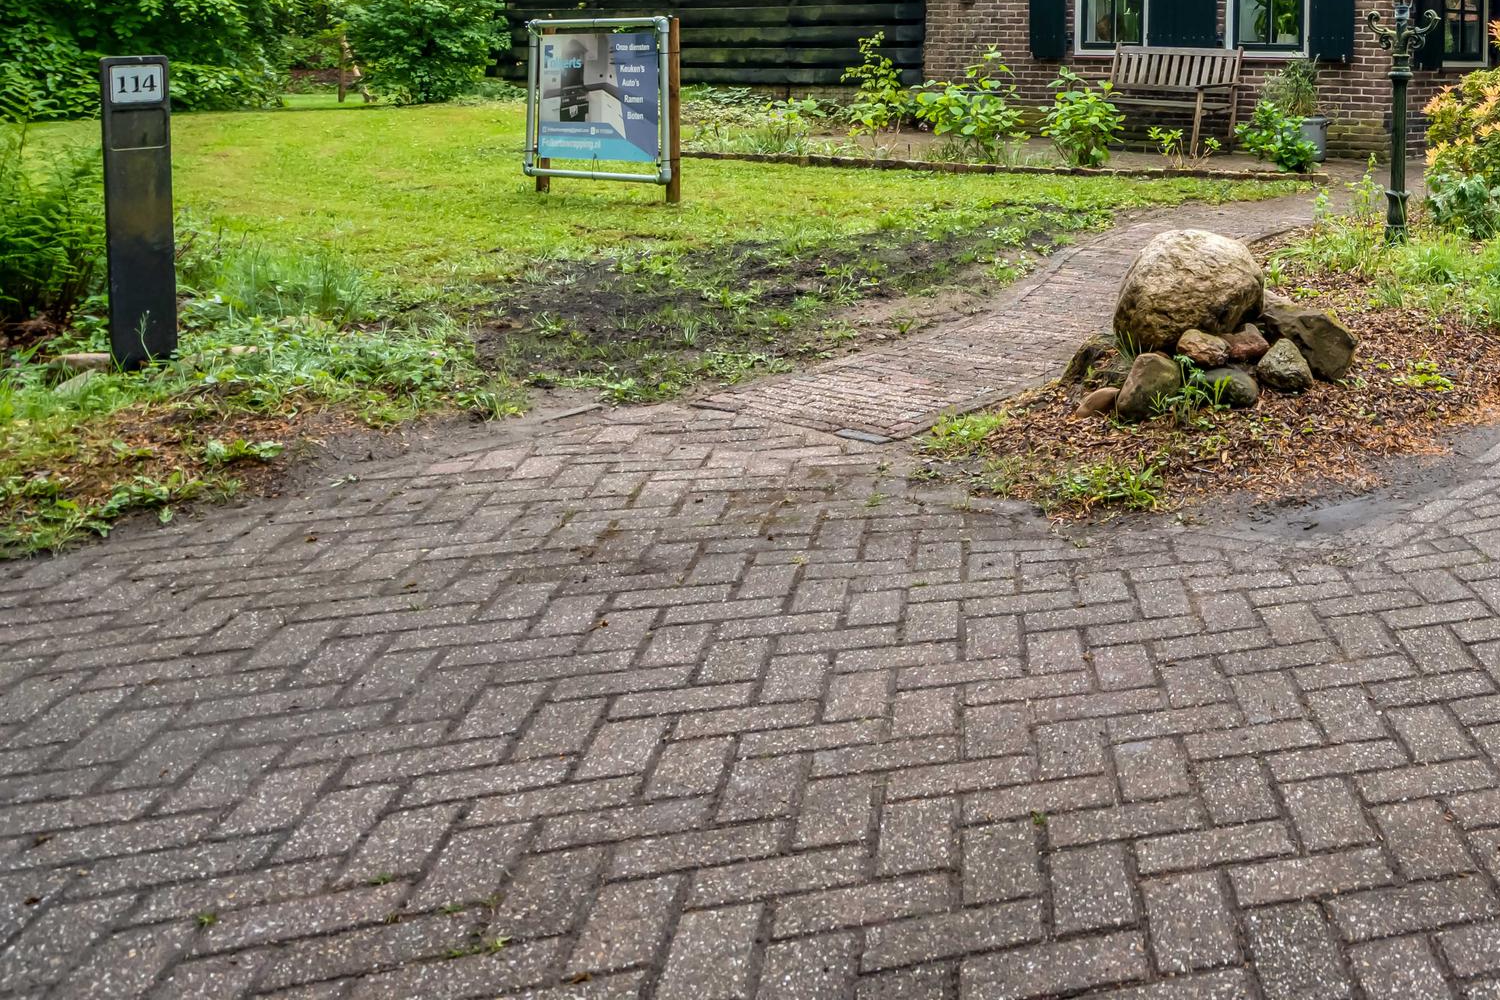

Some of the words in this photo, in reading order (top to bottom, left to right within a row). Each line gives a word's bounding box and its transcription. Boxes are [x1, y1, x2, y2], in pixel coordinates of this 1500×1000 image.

[117, 74, 157, 93] 114
[622, 78, 640, 87] Auto's
[624, 94, 644, 103] Ramen
[627, 111, 644, 120] Boten
